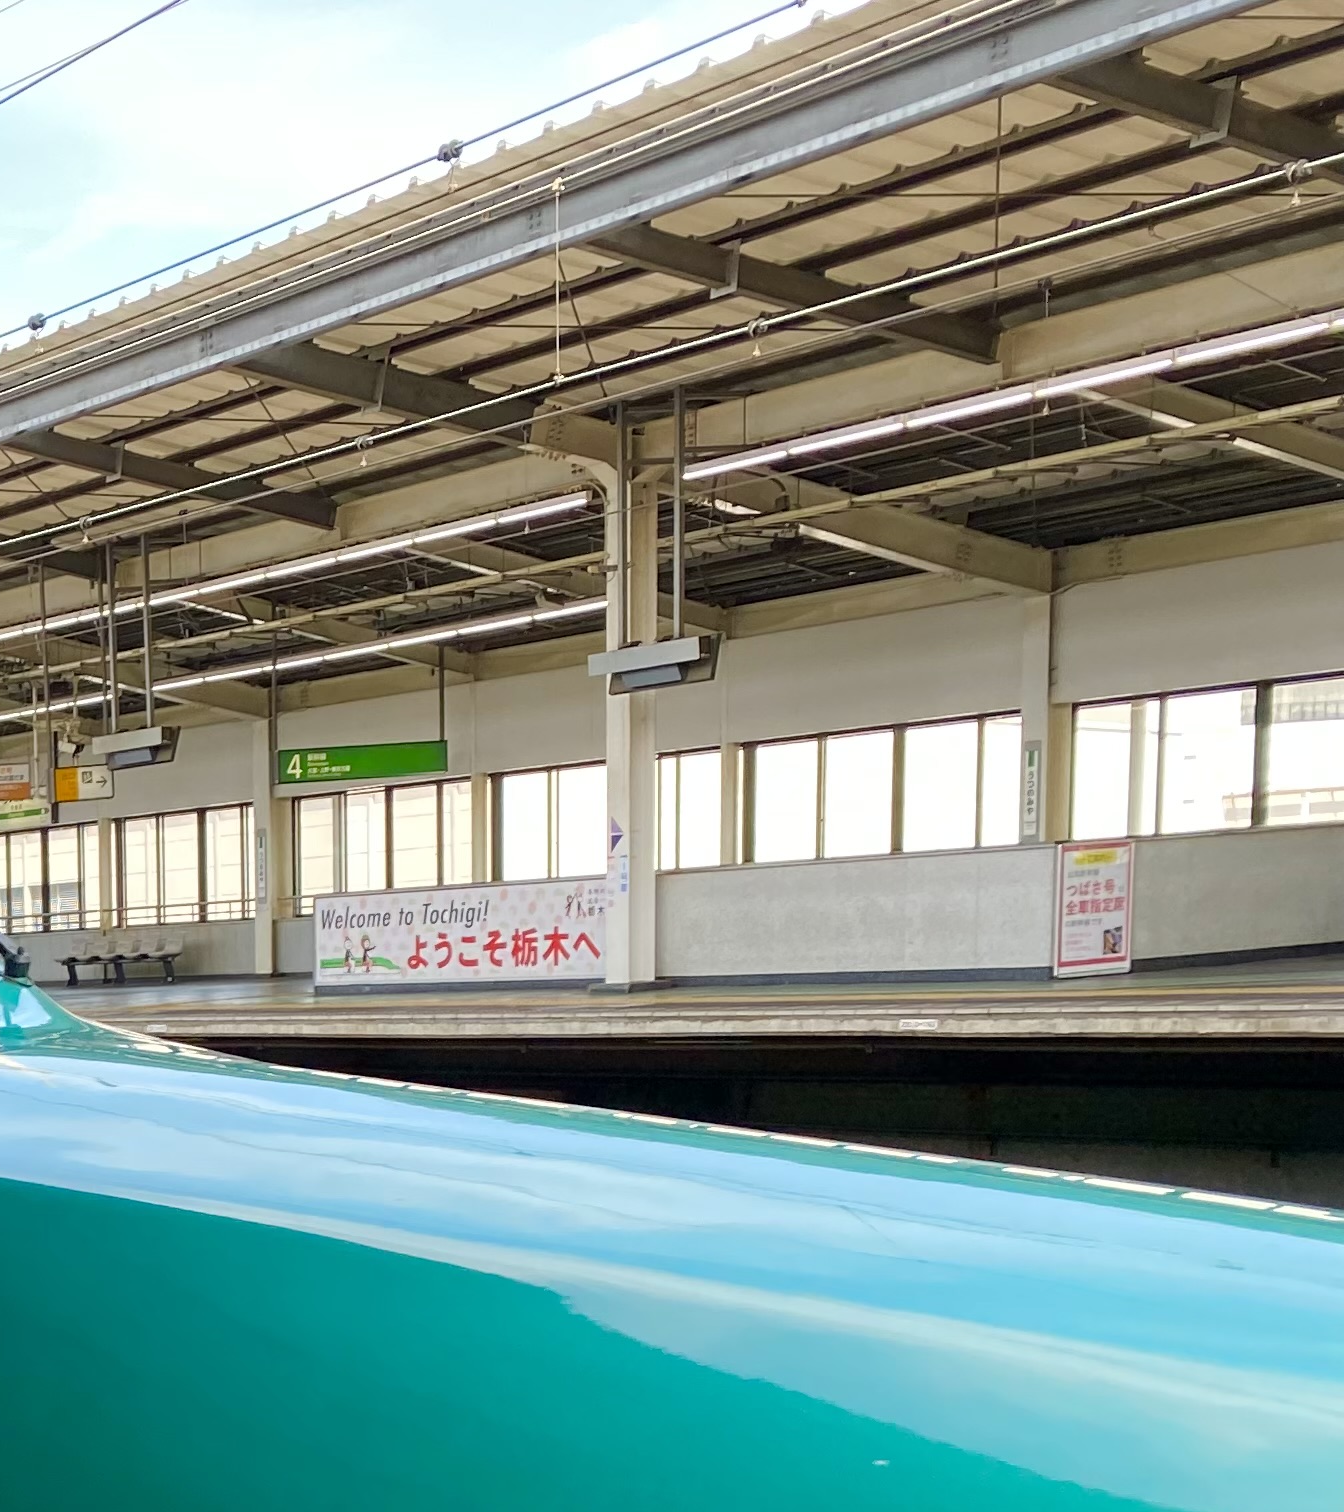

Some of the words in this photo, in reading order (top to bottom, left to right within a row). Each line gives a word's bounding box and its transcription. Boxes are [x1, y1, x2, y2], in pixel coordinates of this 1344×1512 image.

[286, 754, 303, 779] 4
[321, 908, 390, 929] Welcome
[399, 906, 413, 926] to
[422, 900, 490, 928] Tochigi!
[1065, 897, 1125, 916] 全車指定席
[407, 925, 602, 969] ようこそ栃木へ
